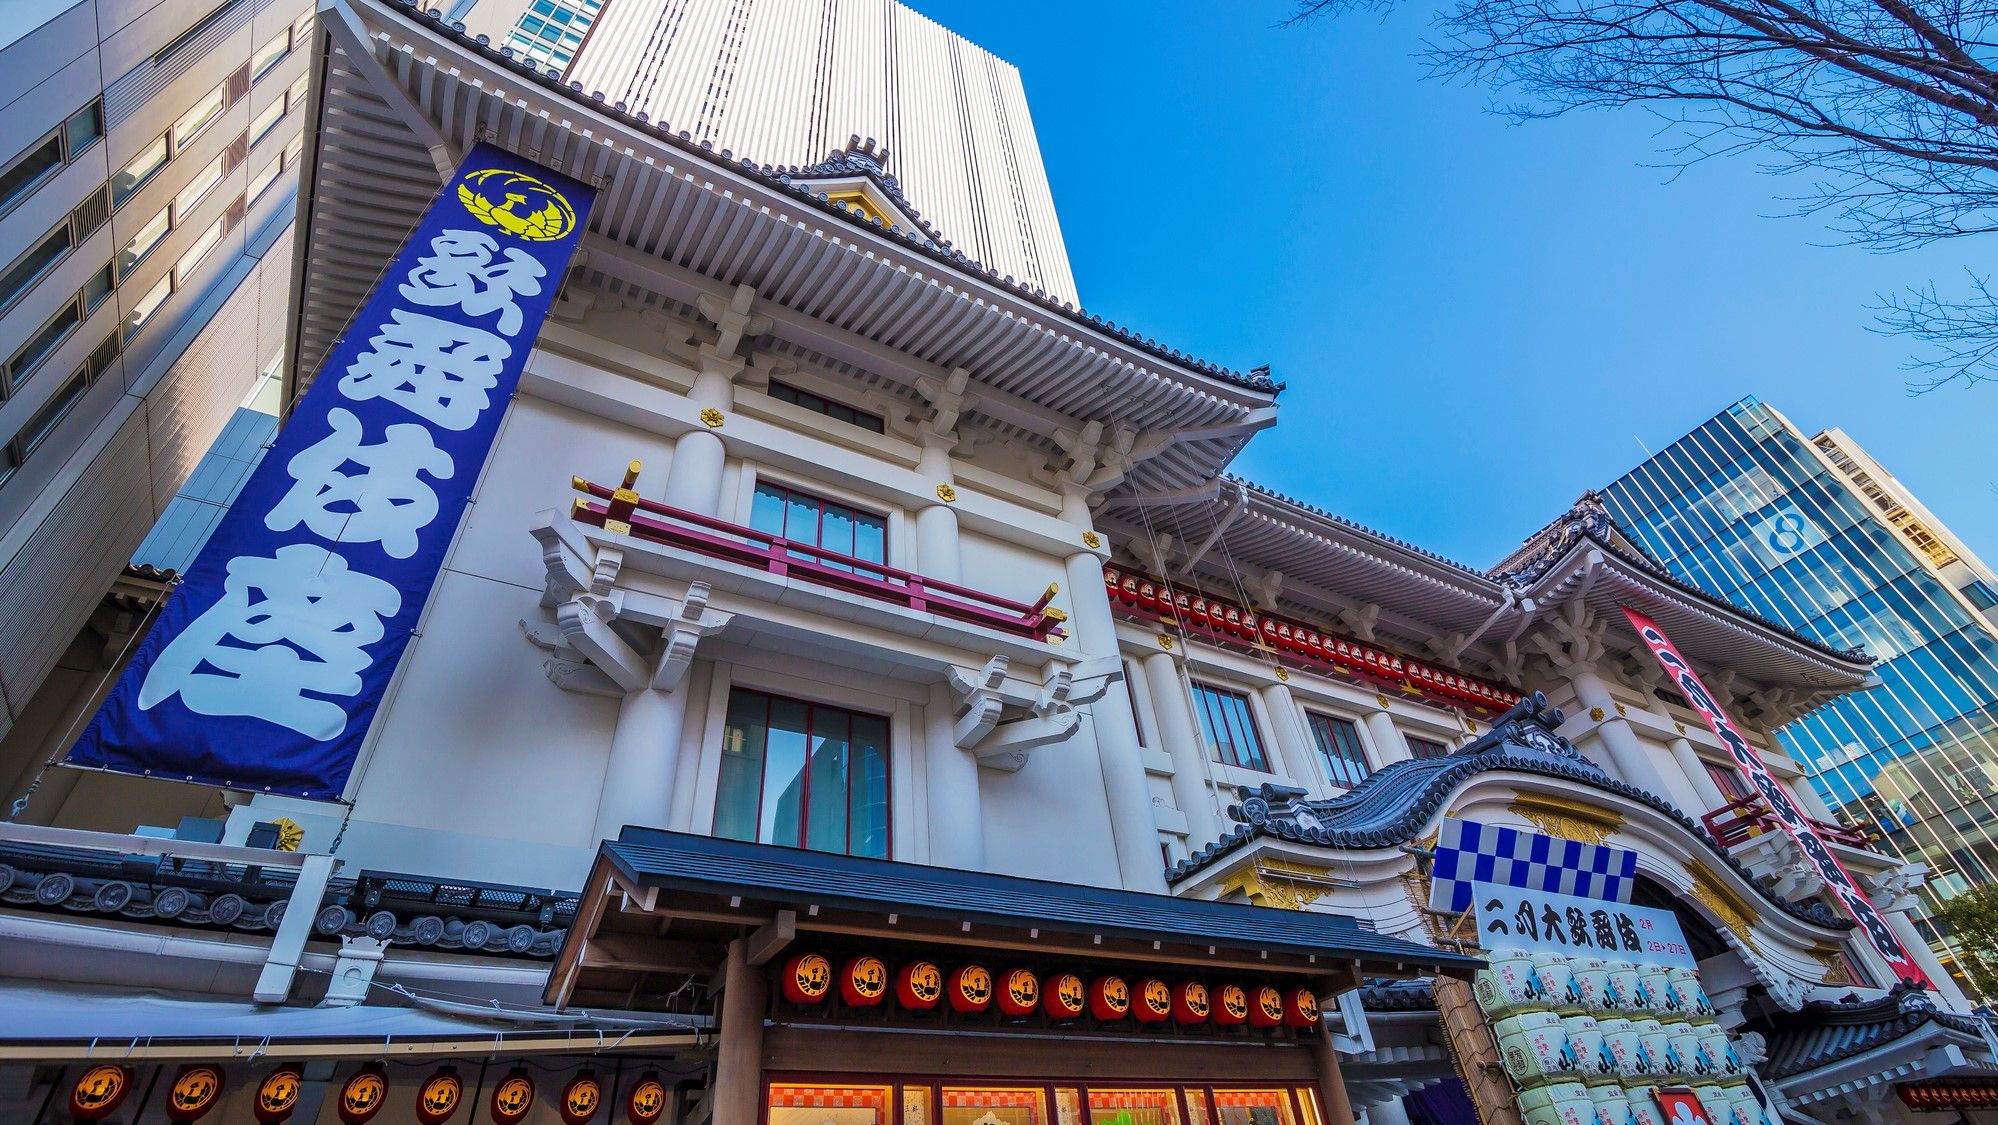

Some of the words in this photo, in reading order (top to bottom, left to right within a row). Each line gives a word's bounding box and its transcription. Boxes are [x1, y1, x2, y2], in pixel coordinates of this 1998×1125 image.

[138, 228, 546, 741] 歌舞伎座
[1641, 625, 1907, 964] 二月大歌舞伎
[1484, 899, 1643, 953] 二月大歌舞伎
[1639, 918, 1654, 932] 2月
